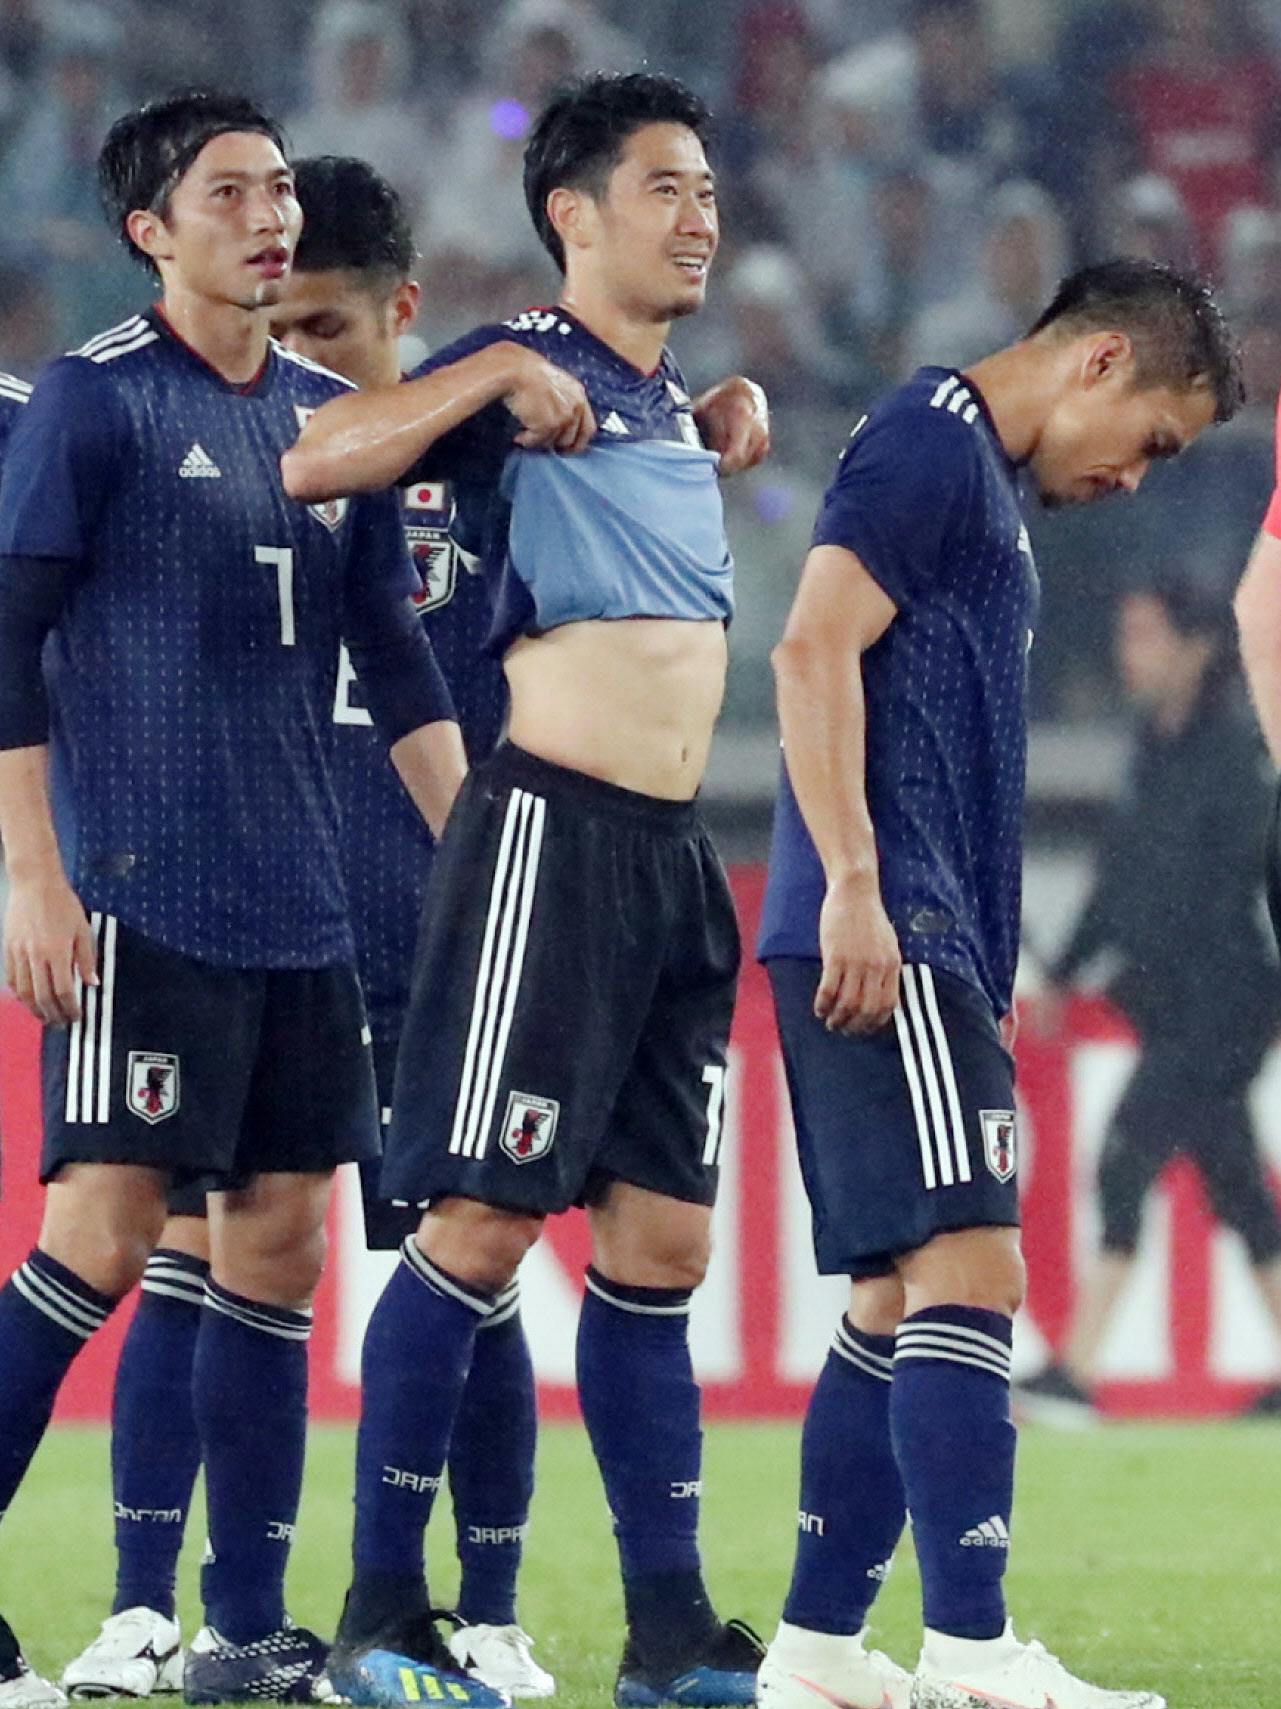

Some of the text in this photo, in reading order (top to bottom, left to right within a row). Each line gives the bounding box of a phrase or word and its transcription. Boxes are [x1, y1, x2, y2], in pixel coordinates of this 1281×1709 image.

[179, 466, 221, 478] adidas
[254, 545, 296, 646] 7
[381, 1465, 444, 1494] JAPA
